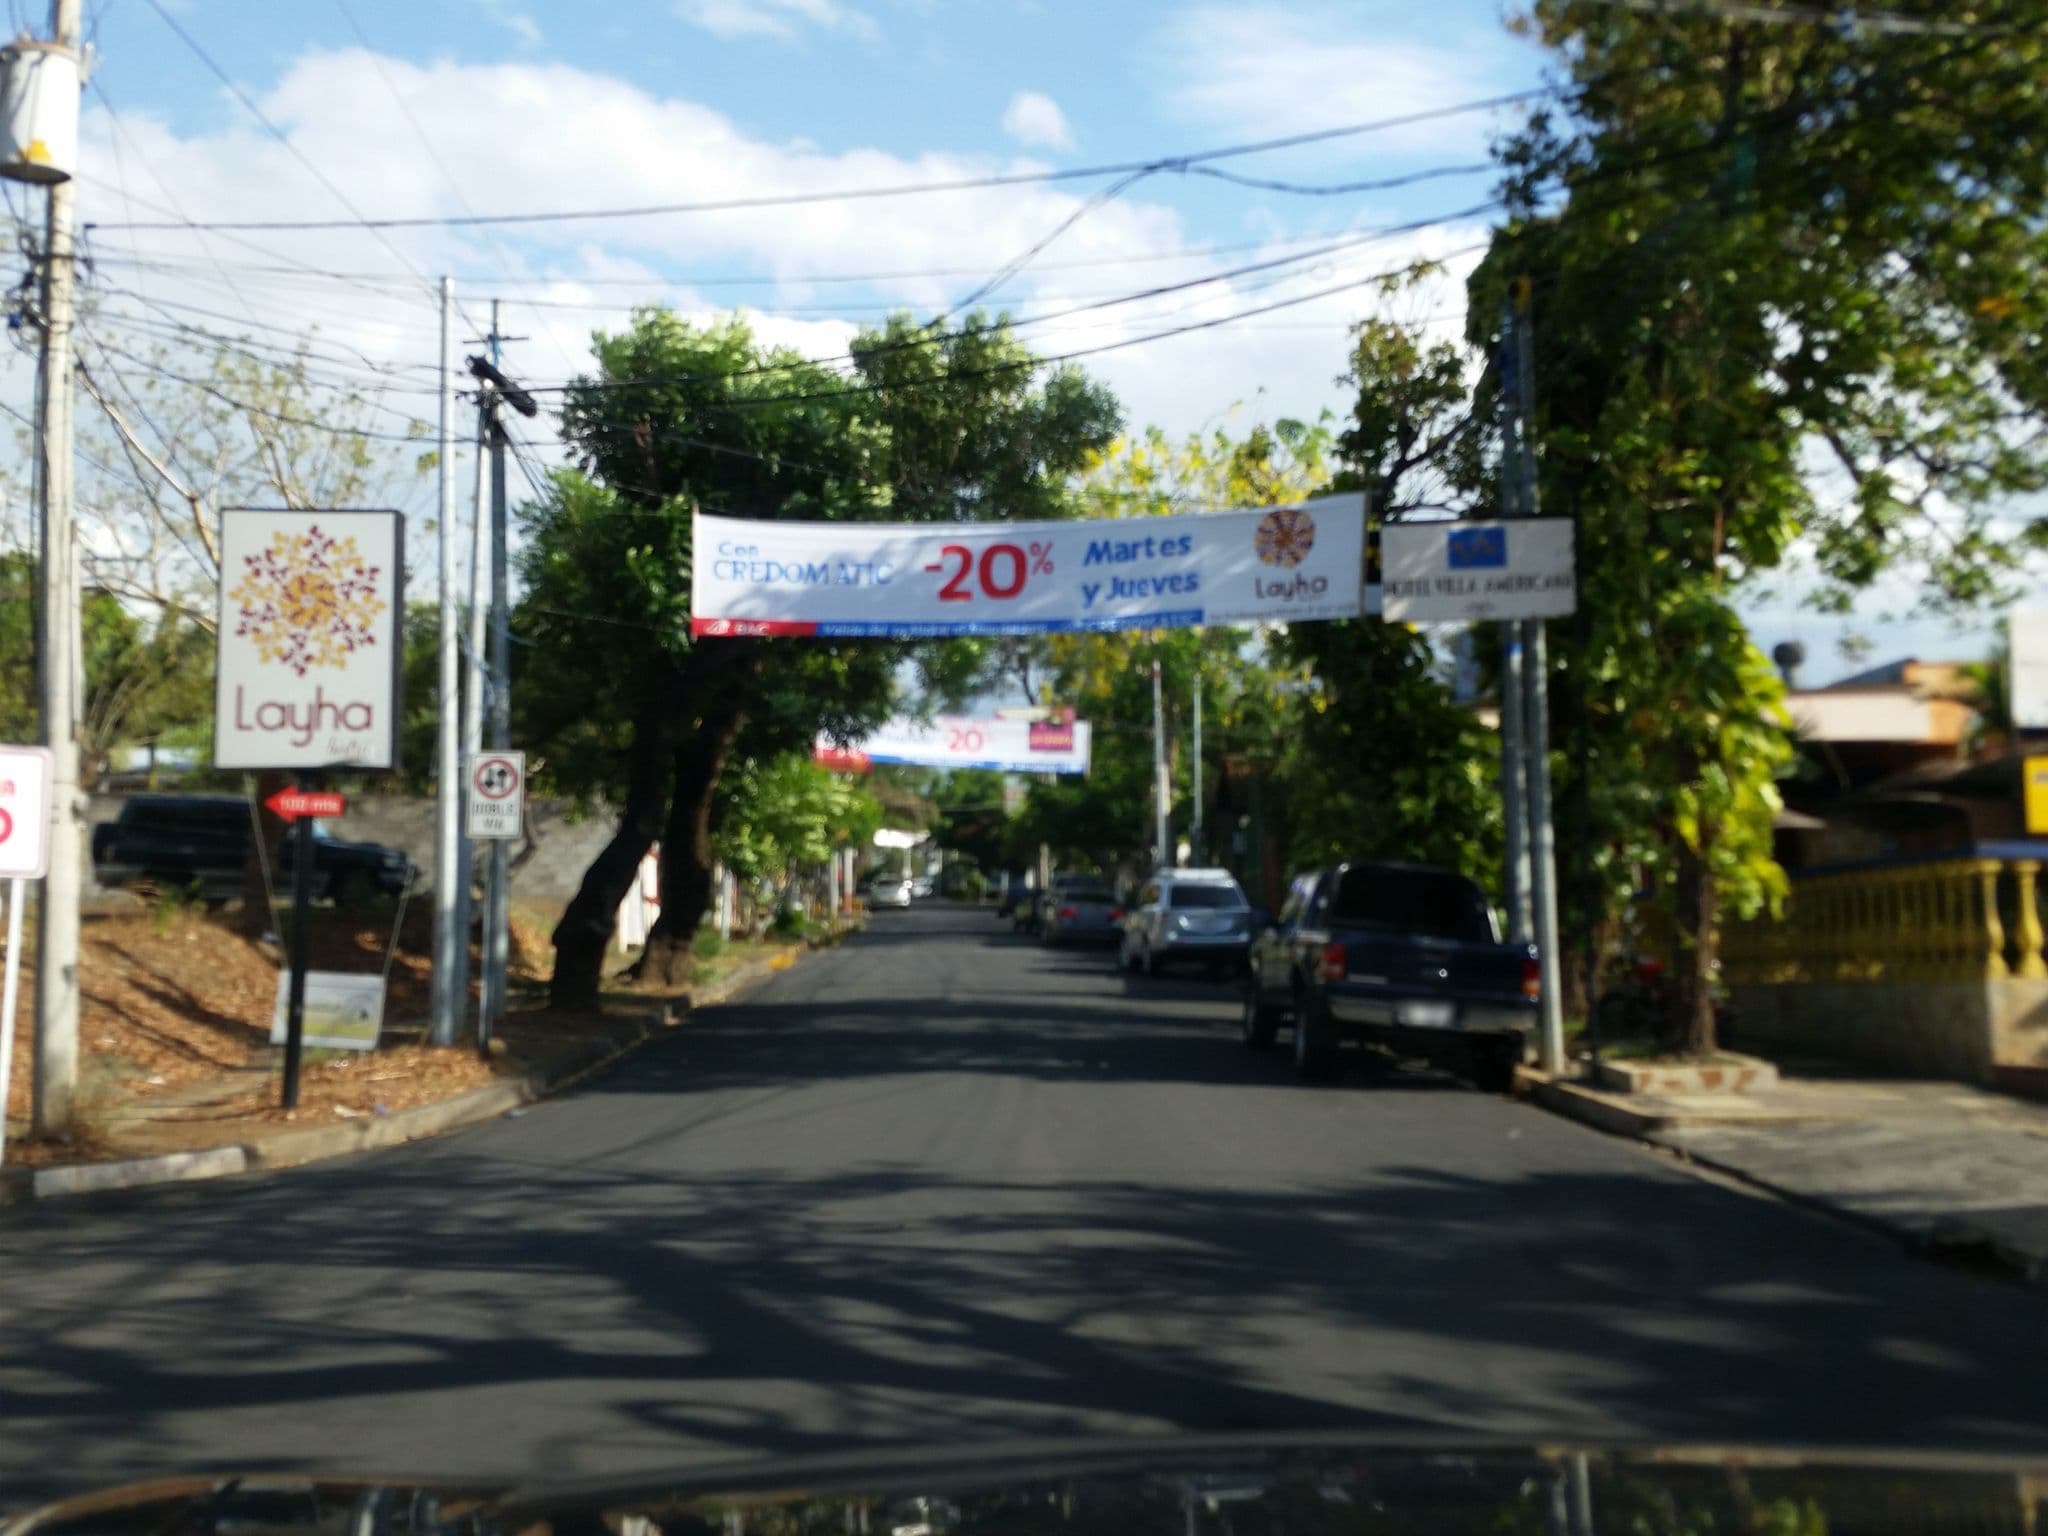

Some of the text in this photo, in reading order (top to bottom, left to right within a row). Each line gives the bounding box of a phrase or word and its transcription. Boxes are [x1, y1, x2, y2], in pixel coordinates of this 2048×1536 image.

[718, 541, 758, 555] Con
[1084, 534, 1193, 566] Martes
[713, 560, 893, 585] CREDOMATIC
[1082, 572, 1198, 609] y Jueves
[1255, 574, 1328, 601] Layha
[235, 685, 373, 747] Layha
